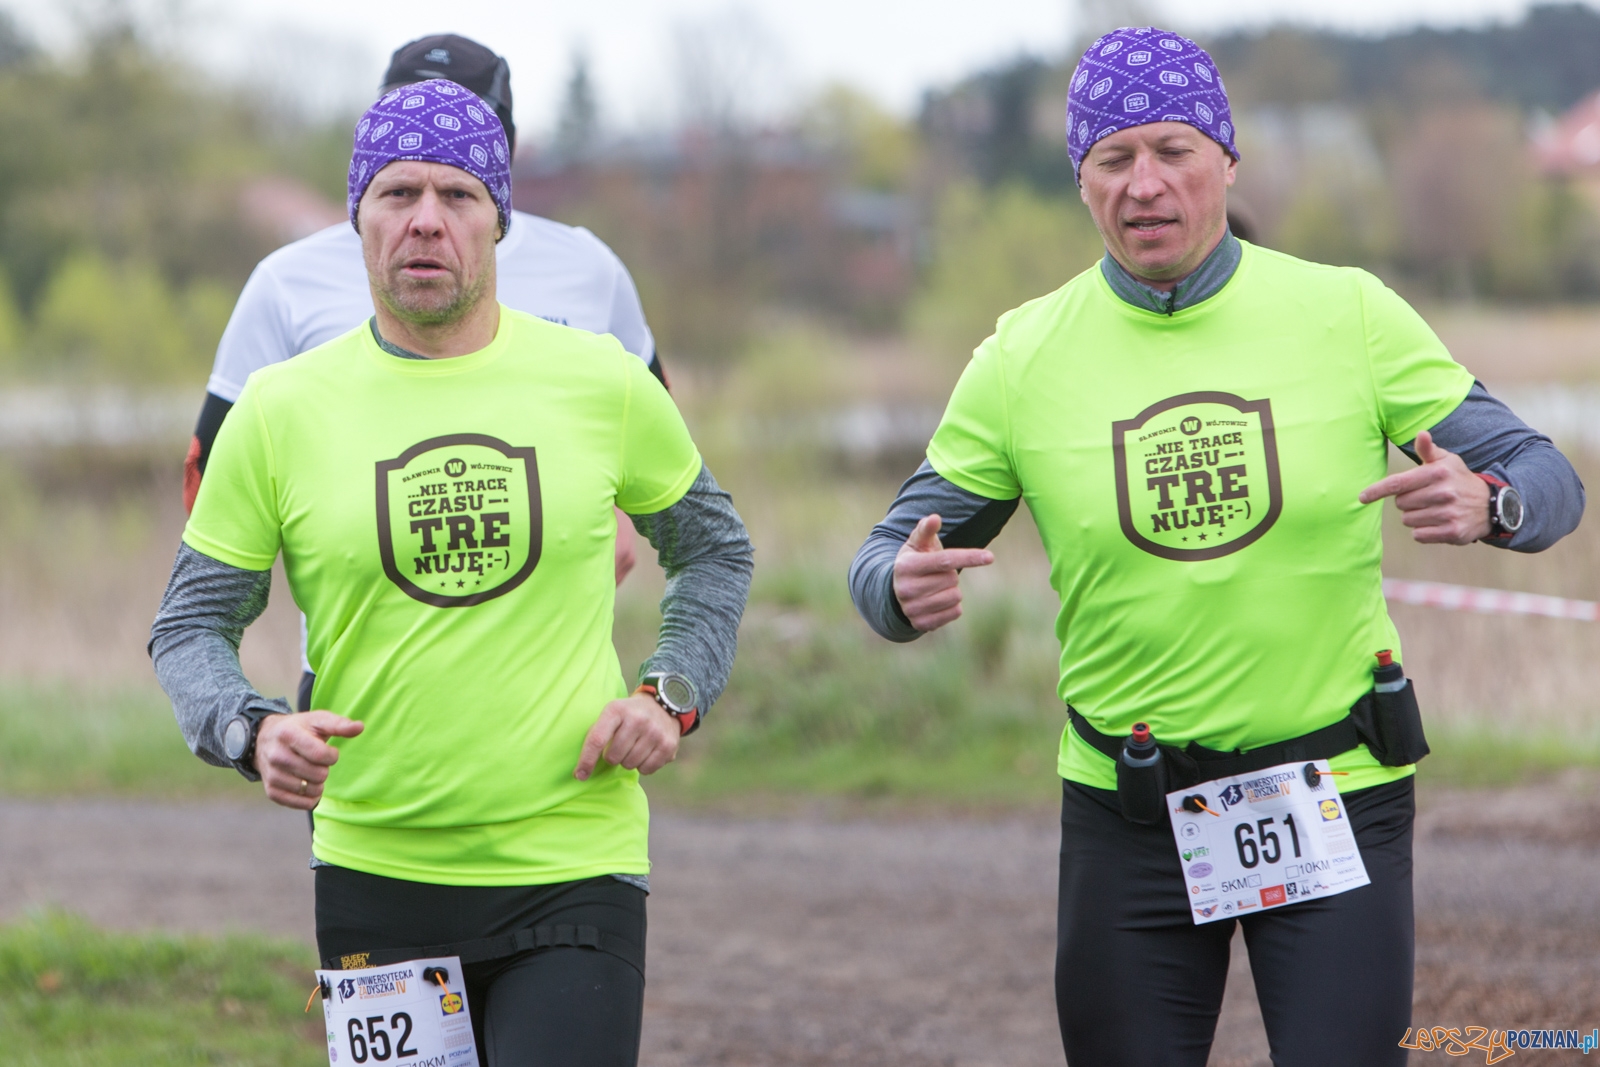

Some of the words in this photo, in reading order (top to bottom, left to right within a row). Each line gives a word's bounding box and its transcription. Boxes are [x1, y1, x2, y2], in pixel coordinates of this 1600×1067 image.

[1183, 420, 1199, 432] W
[1205, 419, 1248, 427] WÓJTOWICZ
[1189, 432, 1243, 450] TRACĘ
[1145, 449, 1220, 475] CZASU
[402, 467, 441, 483] SŁAWOMIR
[447, 461, 464, 474] W
[470, 462, 513, 473] WÓJTOWICZ
[453, 478, 508, 493] TRACĘ
[1146, 463, 1249, 510] TRE
[408, 494, 484, 517] CZASU
[409, 511, 511, 554] TRE
[1242, 770, 1296, 790] UNIWERSYTECKA
[1279, 781, 1291, 797] IV
[1234, 813, 1302, 869] 651
[1300, 859, 1331, 875] 10KM
[1221, 877, 1248, 893] 5KM
[356, 969, 414, 986] UNIWERSYTECKA
[358, 982, 395, 996] ZADYSZKA
[395, 980, 406, 994] IV
[347, 1011, 418, 1064] 652
